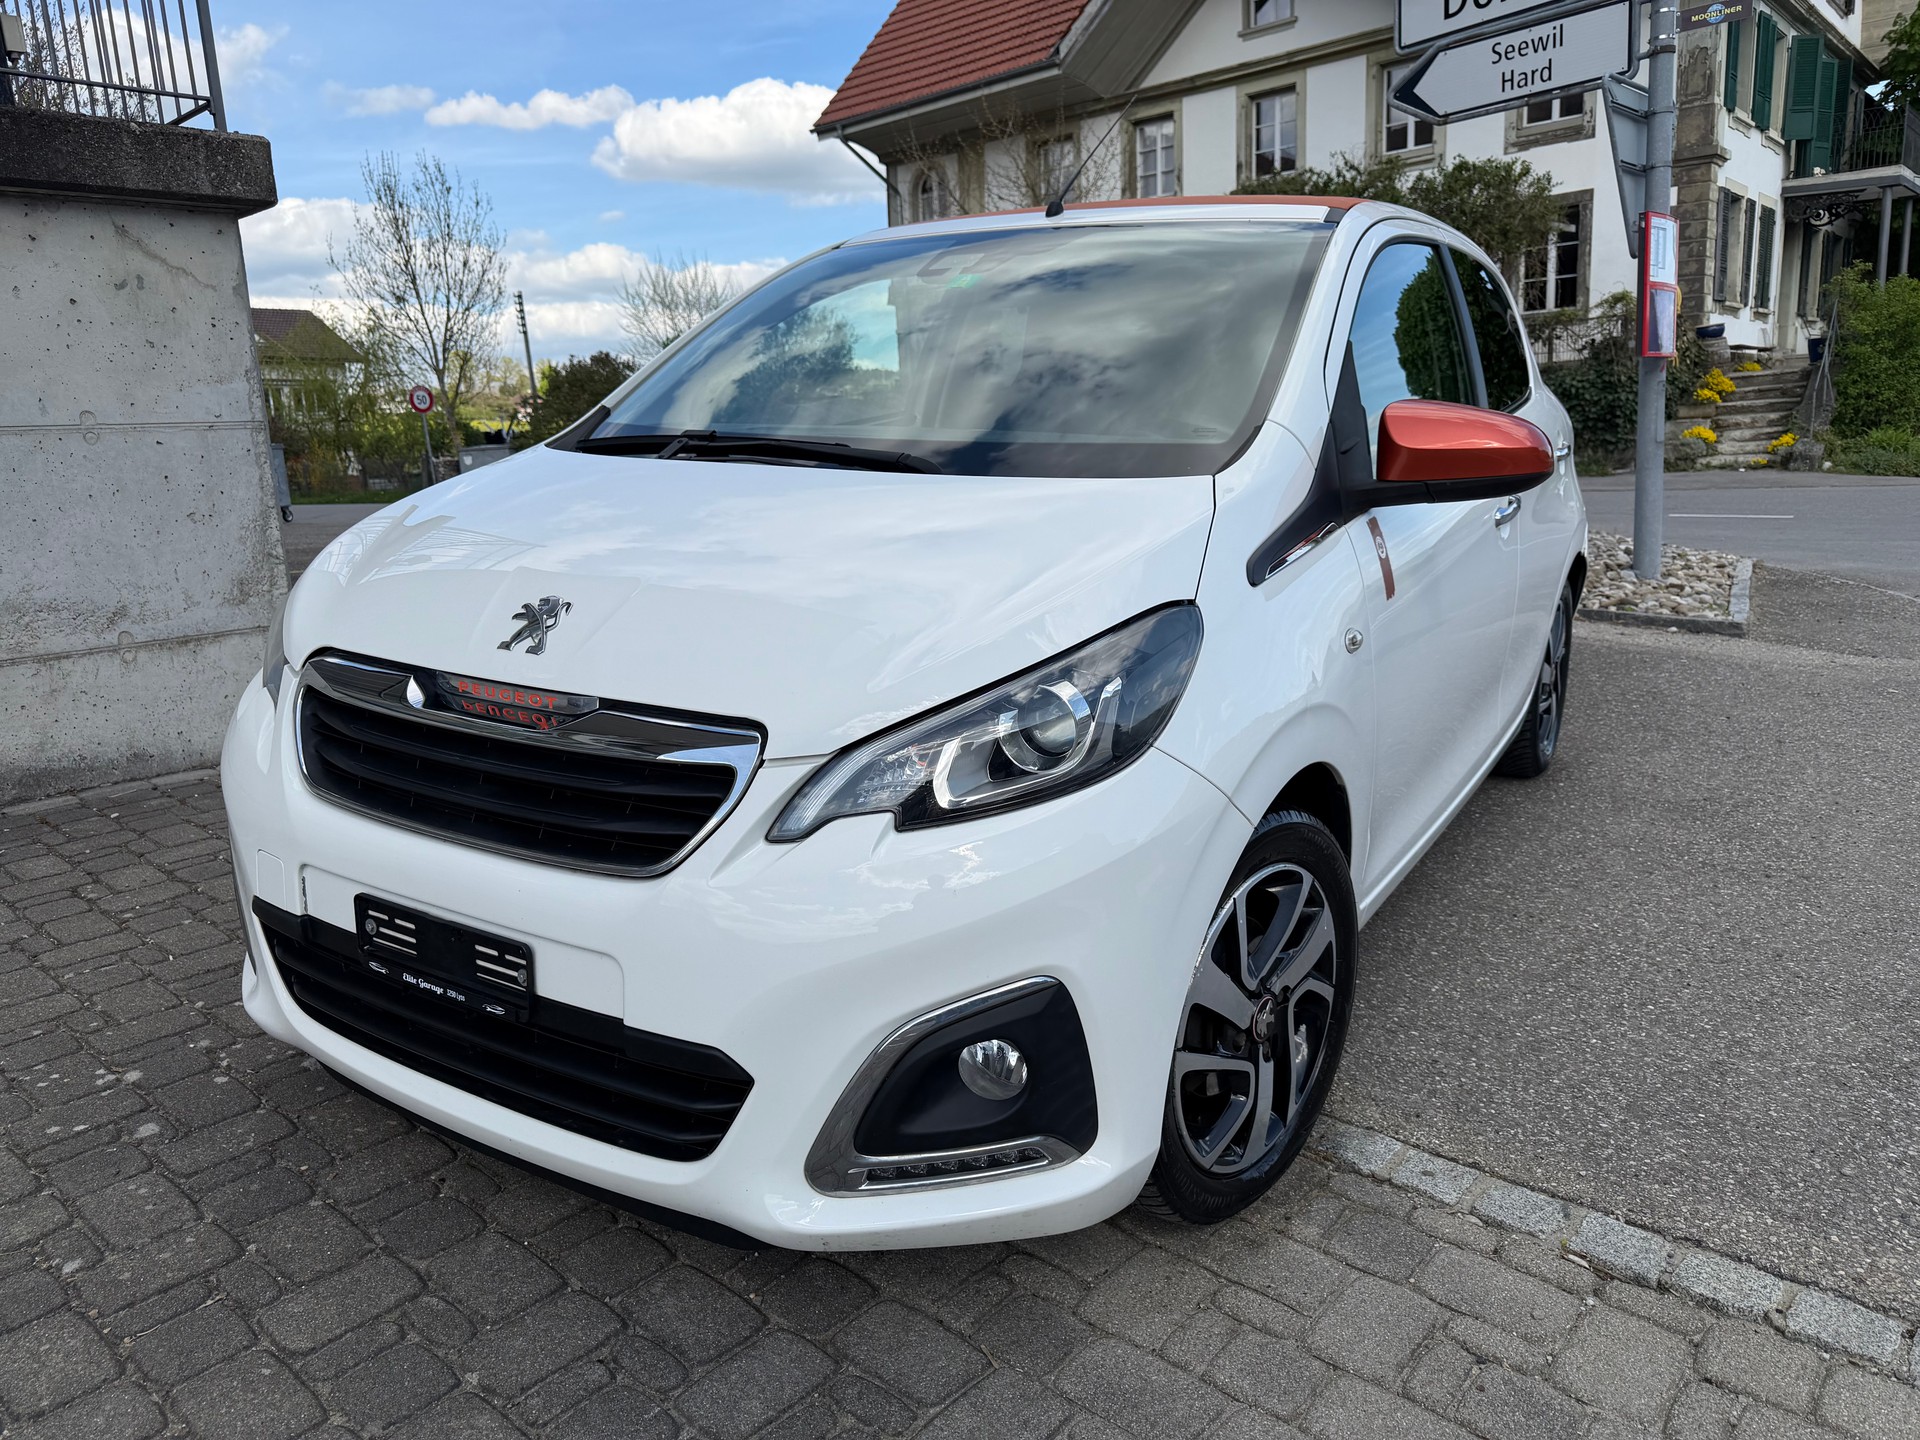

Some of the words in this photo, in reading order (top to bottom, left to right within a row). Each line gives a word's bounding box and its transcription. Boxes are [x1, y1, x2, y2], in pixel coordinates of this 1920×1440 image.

[1691, 5, 1742, 22] MOONLINER
[1491, 23, 1564, 65] Seewil
[1501, 58, 1553, 93] Hard
[416, 394, 427, 405] 50
[458, 681, 558, 709] PEUGEOT
[403, 973, 417, 984] Elite
[418, 978, 443, 994] Garage
